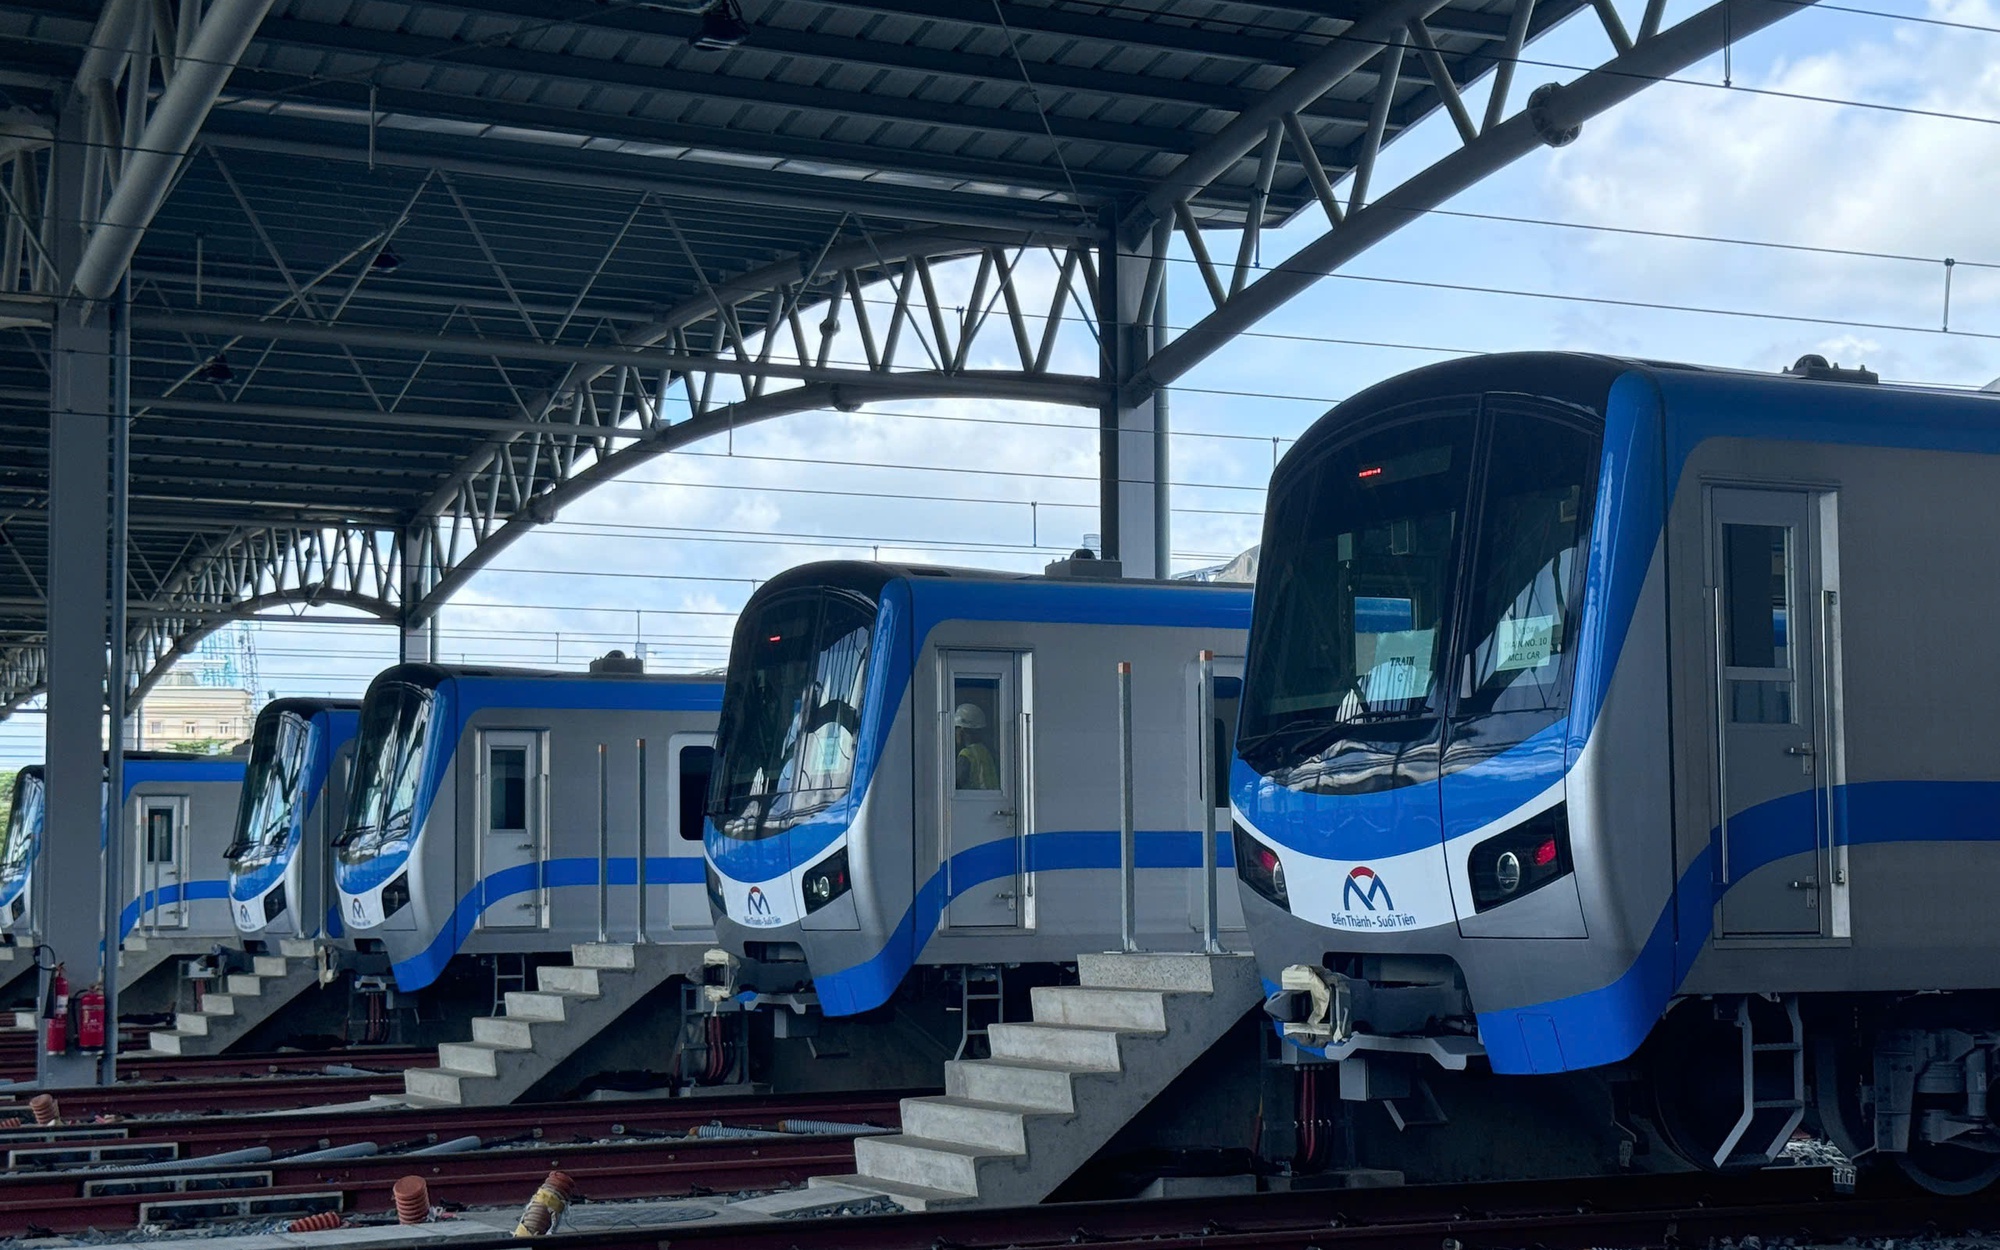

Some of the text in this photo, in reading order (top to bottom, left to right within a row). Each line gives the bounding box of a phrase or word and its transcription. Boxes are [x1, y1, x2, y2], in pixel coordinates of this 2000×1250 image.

[1503, 640, 1523, 649] TAN
[1539, 636, 1548, 646] 10
[1389, 655, 1416, 667] TRAIN
[1526, 650, 1541, 660] CAR
[1331, 912, 1346, 926] Bến
[1345, 914, 1372, 927] Thành
[1377, 913, 1396, 927] Suối
[1395, 913, 1416, 926] Tiên
